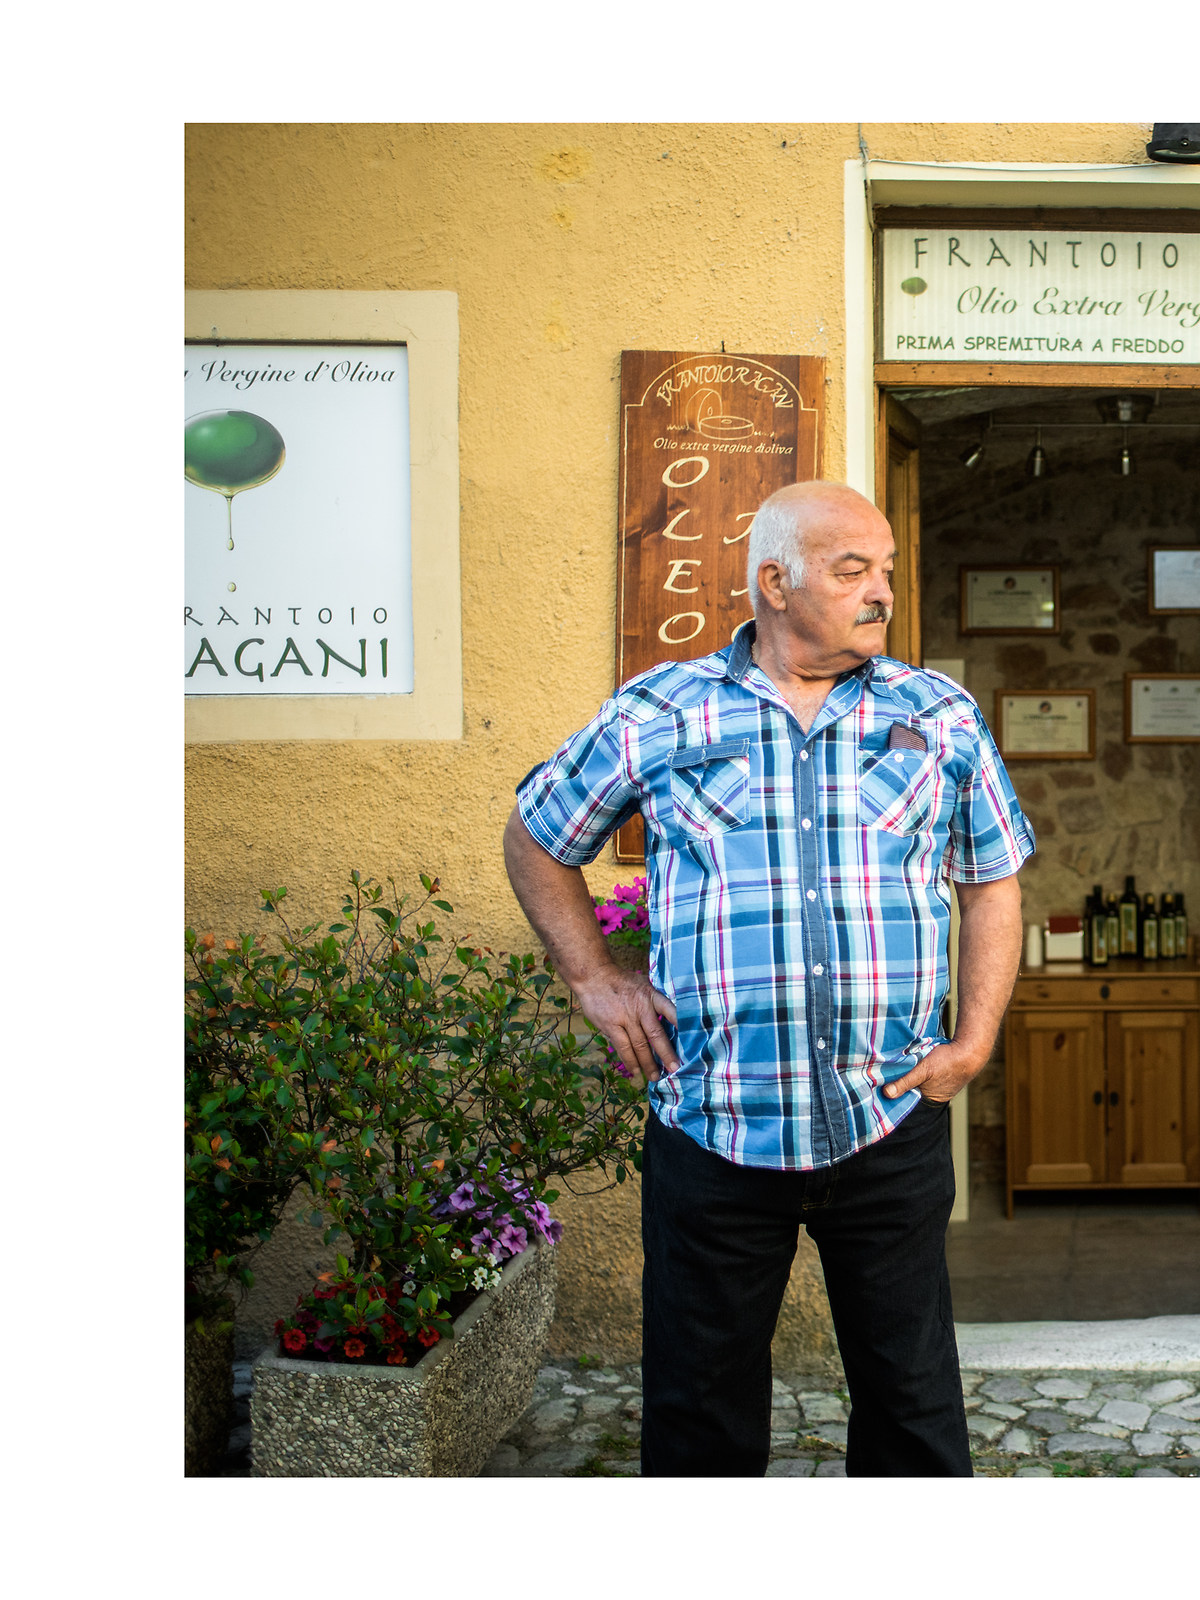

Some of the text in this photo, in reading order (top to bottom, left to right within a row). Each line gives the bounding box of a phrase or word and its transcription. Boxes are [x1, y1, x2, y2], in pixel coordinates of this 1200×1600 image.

[913, 237, 1180, 270] FRANTOIO
[957, 286, 1019, 316] Olio
[1033, 286, 1125, 317] Extra
[897, 335, 1184, 354] PRIMA SPREMITURA A FREDDO
[201, 360, 397, 390] Vergine d'Oliva
[653, 437, 678, 450] Olio
[680, 440, 710, 451] extra
[712, 442, 751, 454] vergine
[184, 606, 388, 627] RANTOIO
[184, 636, 388, 683] AGANI
